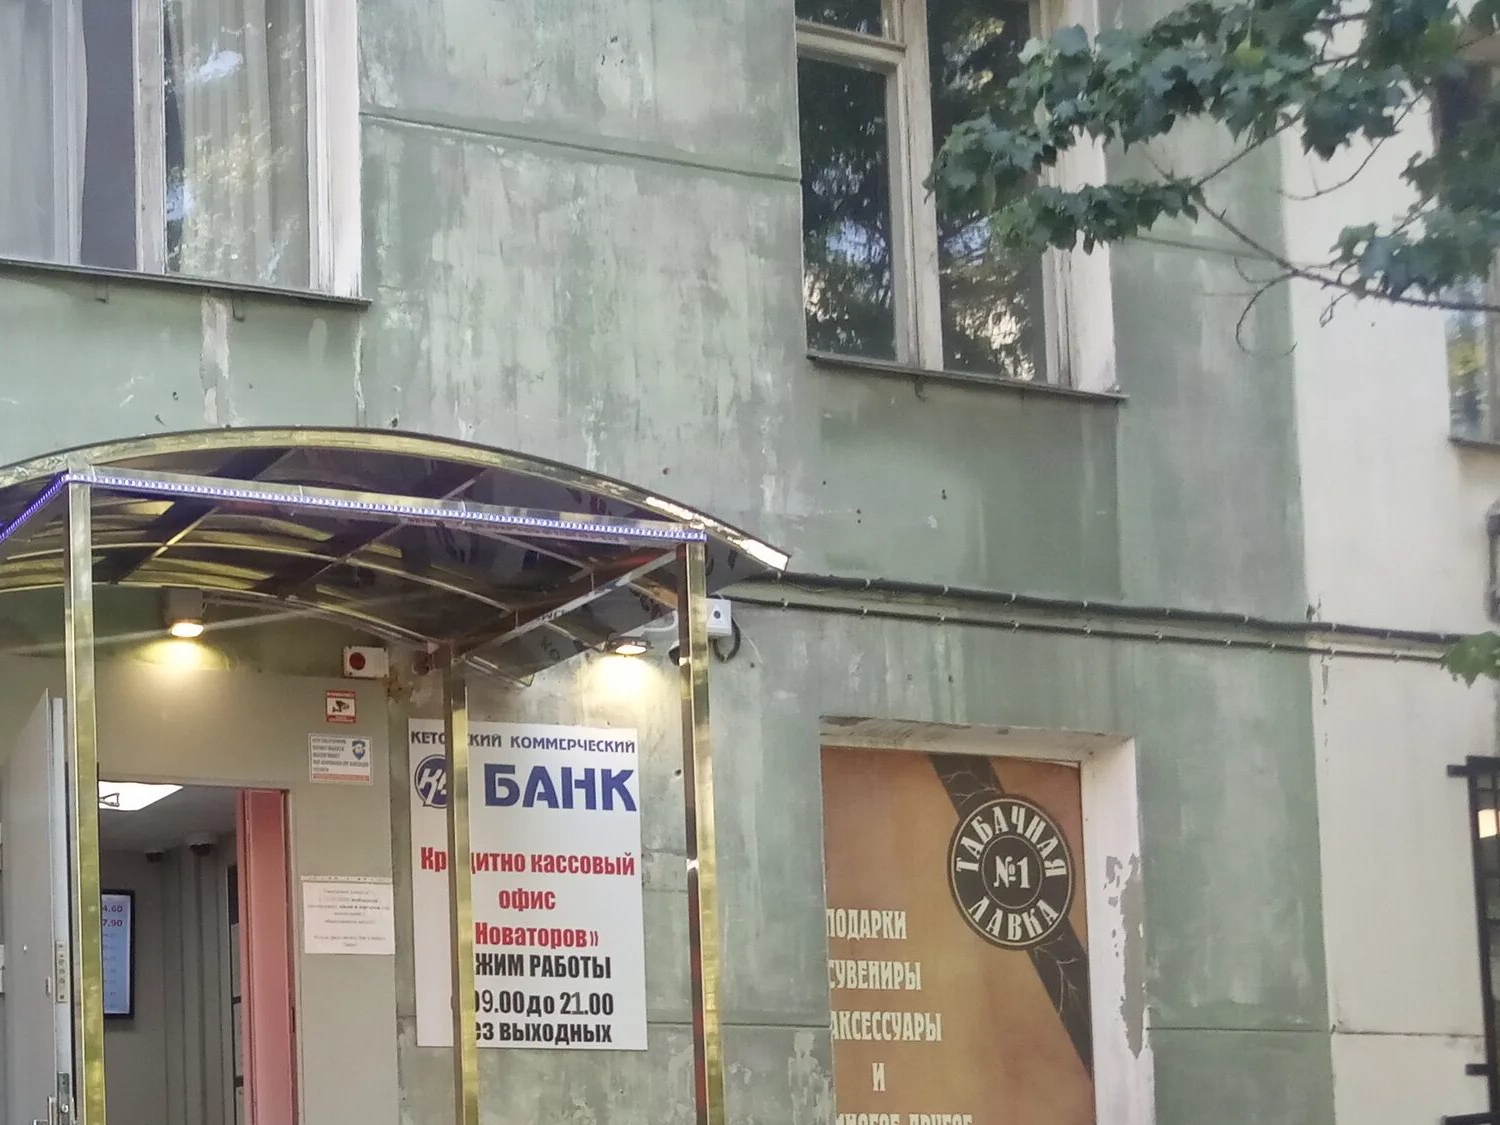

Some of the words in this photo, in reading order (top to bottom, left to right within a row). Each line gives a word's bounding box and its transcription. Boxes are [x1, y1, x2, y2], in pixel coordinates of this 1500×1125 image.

[510, 736, 635, 753] КОММЕРЧЕСКИЙ
[484, 763, 637, 812] БАНК
[956, 805, 1067, 878] ТАБАЧНАЯ
[420, 846, 526, 874] Критно
[530, 851, 636, 876] кассовый
[498, 888, 556, 912] офис
[826, 908, 908, 940] ПОДАРКИ
[968, 896, 1059, 941] ЛАВКА
[475, 952, 525, 977] ЖИМ
[529, 954, 612, 979] РАБОТЫ
[828, 959, 922, 991] СУВЕНИРЫ
[559, 991, 614, 1016] 21.00
[871, 1062, 886, 1092] И
